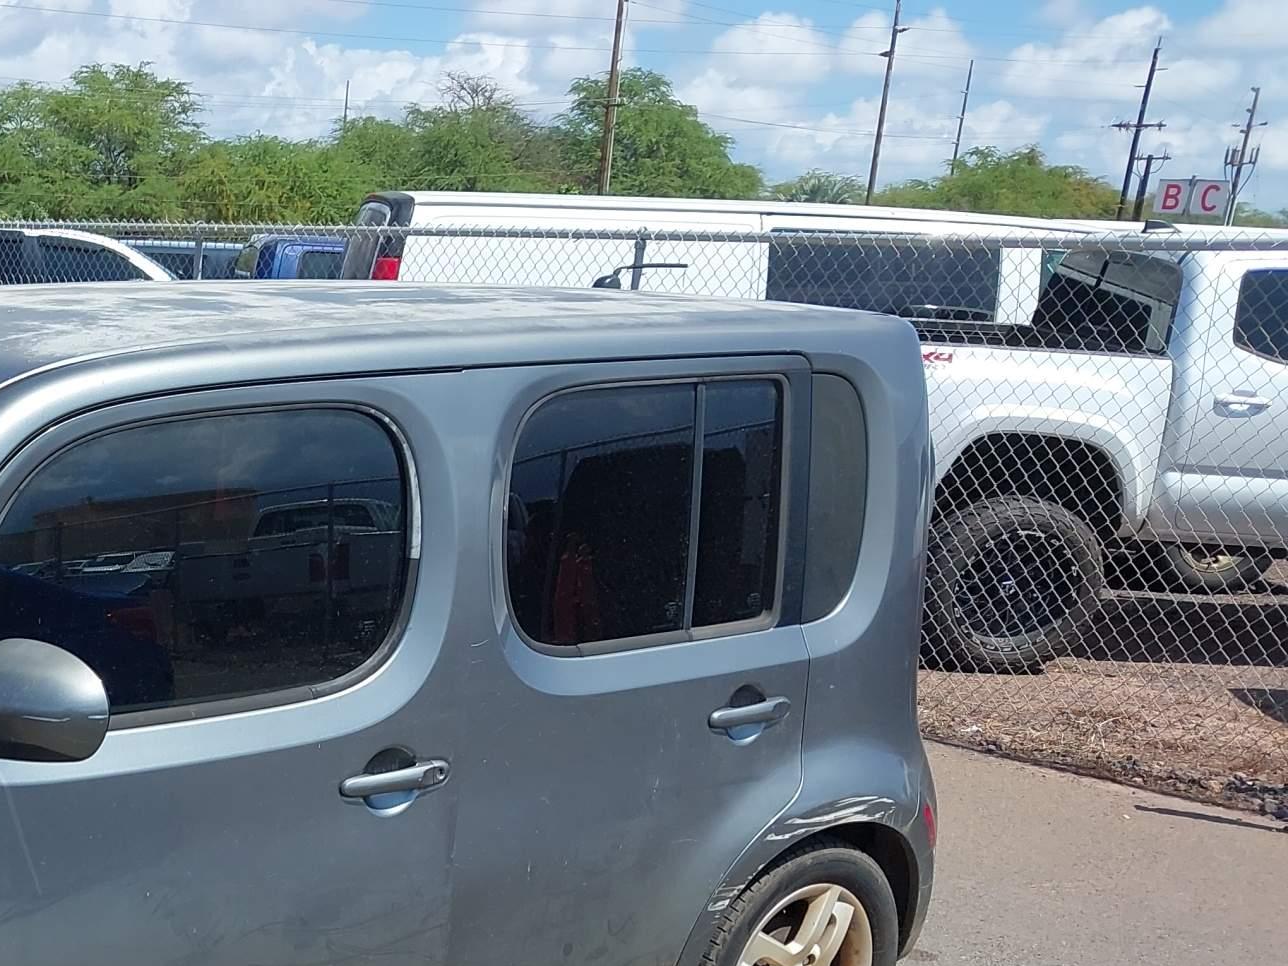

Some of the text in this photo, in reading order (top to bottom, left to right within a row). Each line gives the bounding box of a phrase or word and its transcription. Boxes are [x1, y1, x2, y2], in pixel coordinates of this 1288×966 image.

[1161, 183, 1221, 212] B C
[922, 351, 953, 364] X4
